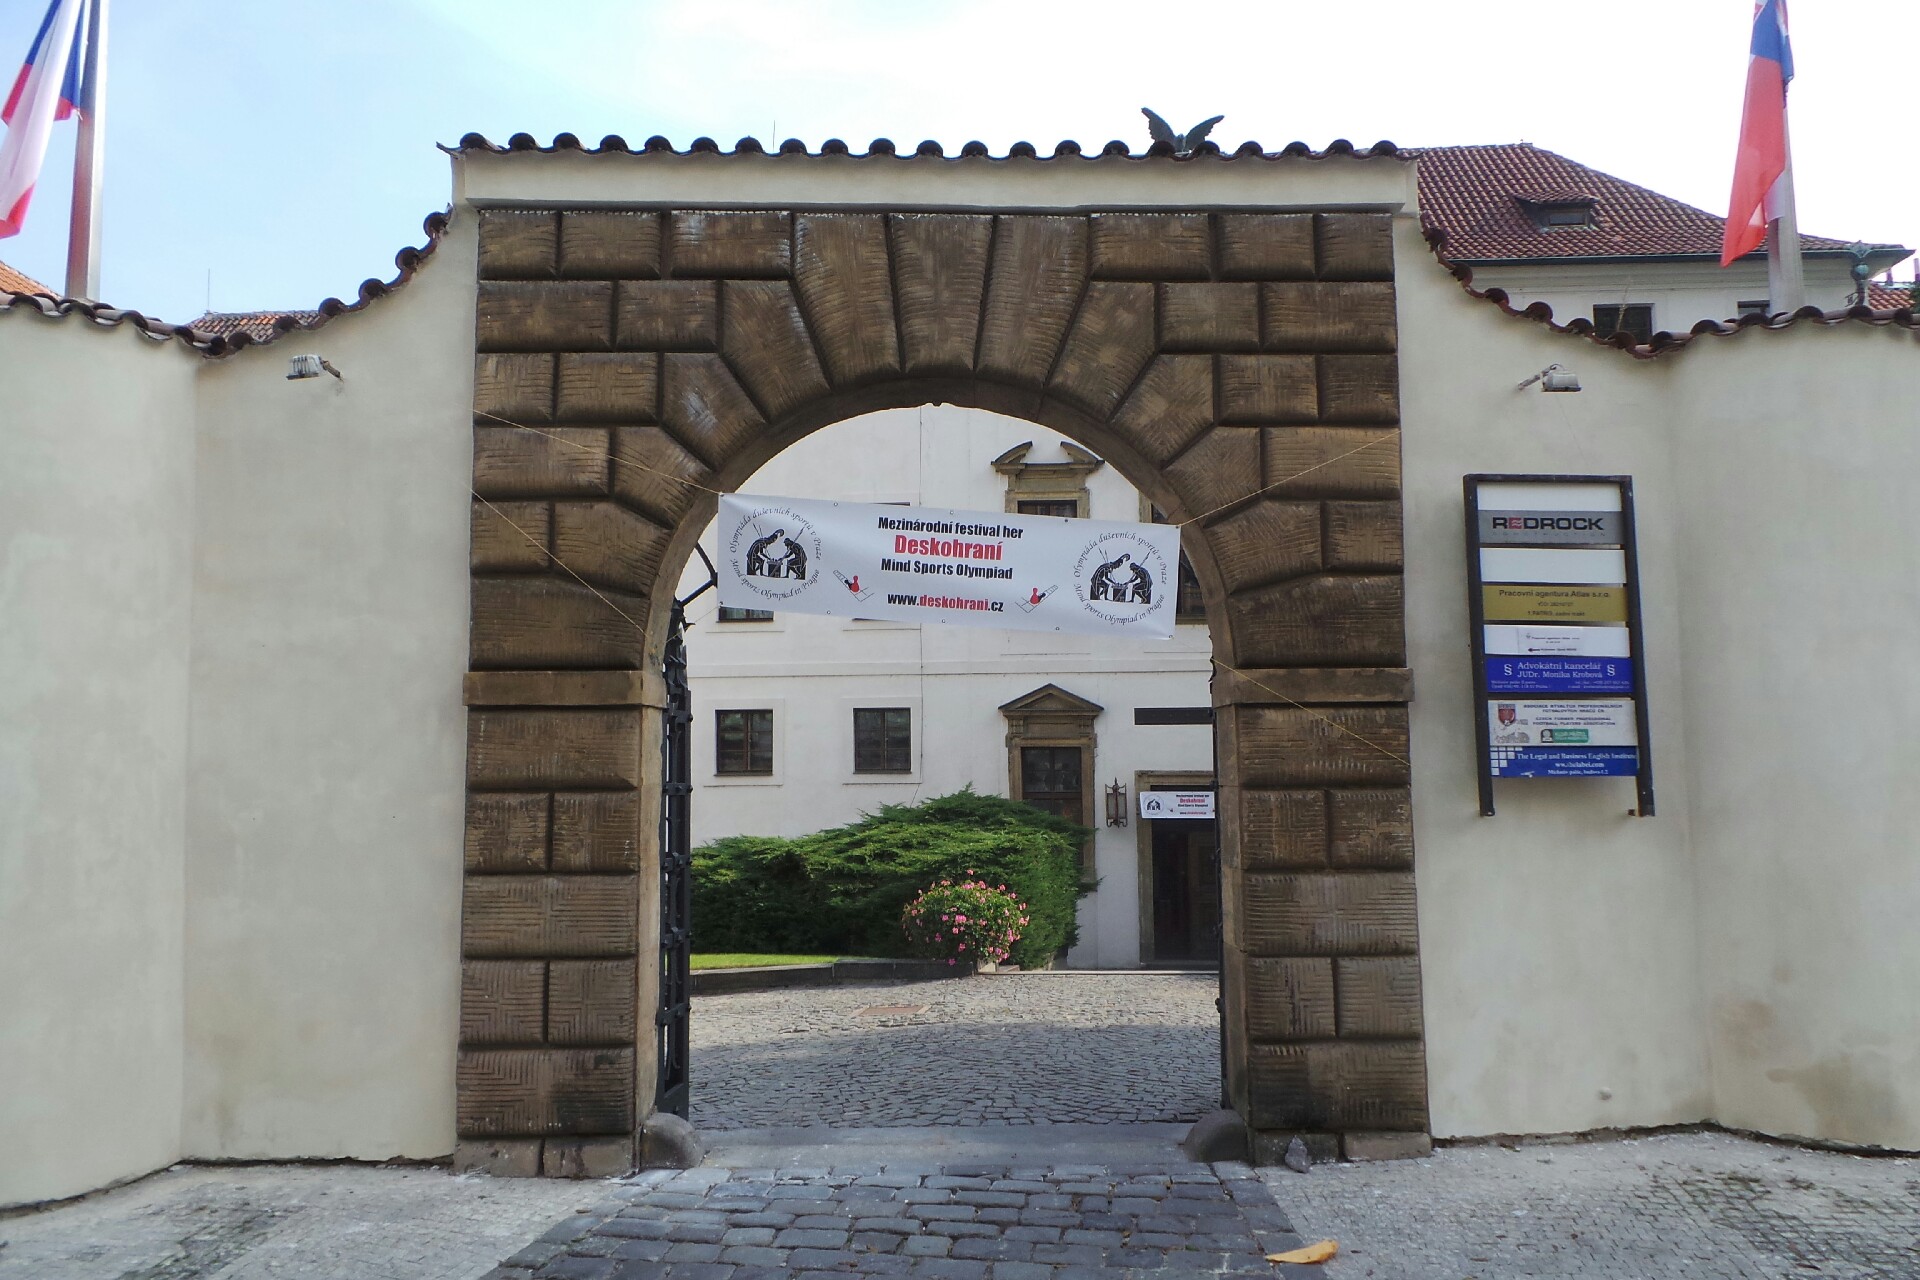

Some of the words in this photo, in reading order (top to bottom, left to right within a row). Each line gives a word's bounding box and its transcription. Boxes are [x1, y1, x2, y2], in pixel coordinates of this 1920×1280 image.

[878, 517, 953, 534] Mezinárodní
[955, 522, 1000, 537] festival
[1003, 526, 1024, 538] her
[1492, 517, 1604, 530] REDROCK
[894, 535, 1003, 560] Deskohraní
[881, 558, 911, 572] Mind
[914, 561, 953, 575] Sports
[956, 564, 1013, 579] Olympiad
[1536, 590, 1569, 598] agentura
[887, 594, 1004, 612] www.deskohrani.cz
[1104, 612, 1138, 625] Olympiad
[1517, 662, 1562, 670] Advokátní
